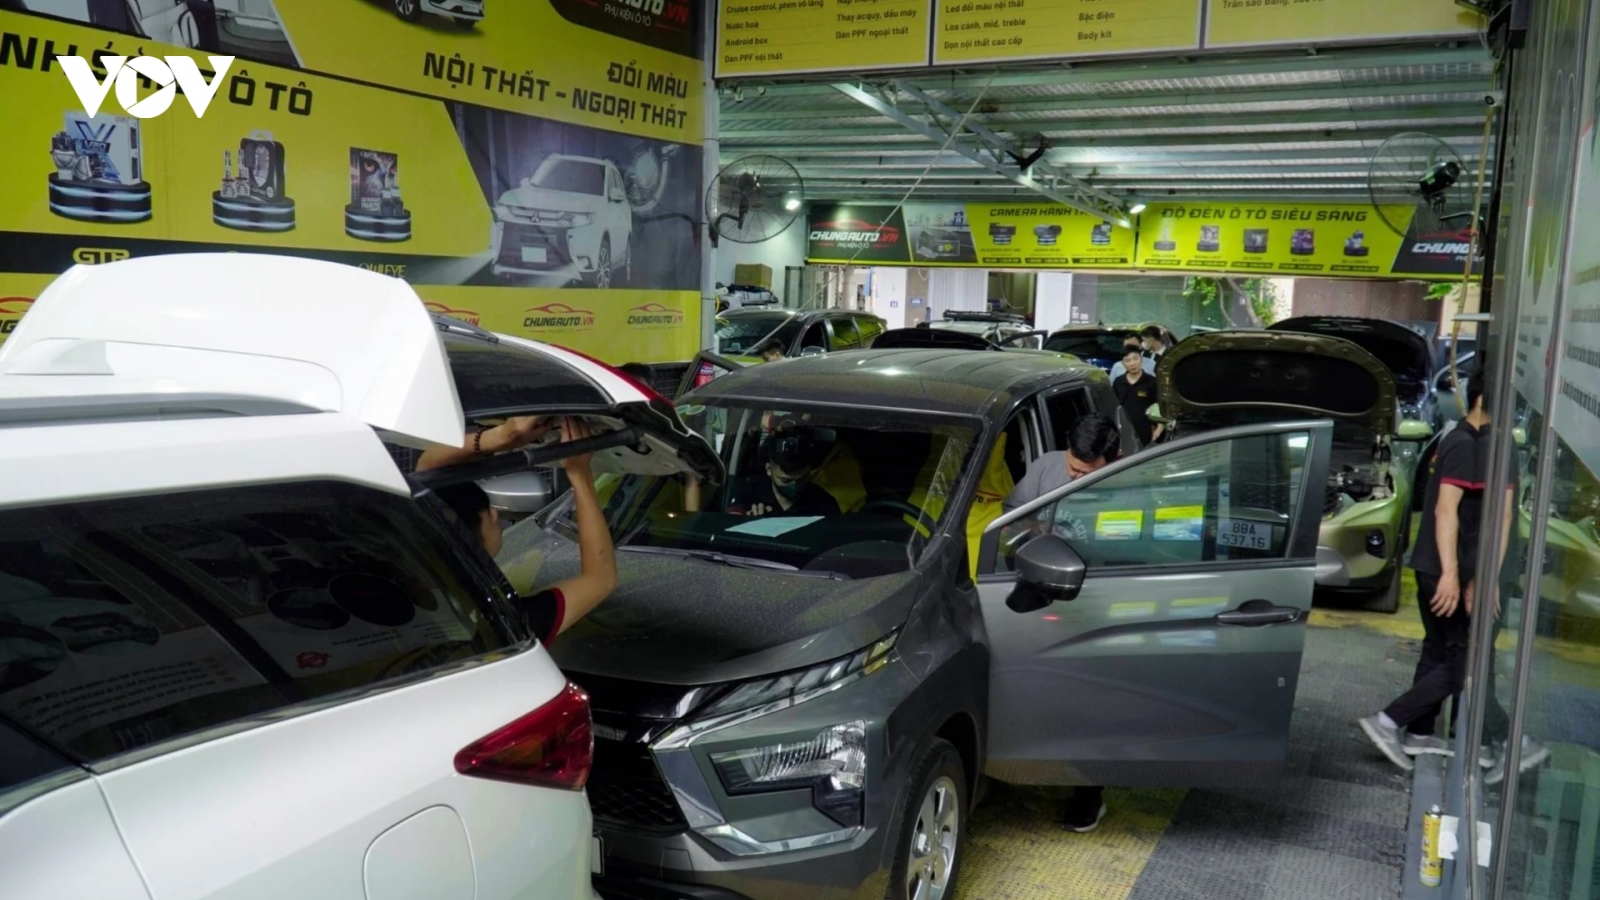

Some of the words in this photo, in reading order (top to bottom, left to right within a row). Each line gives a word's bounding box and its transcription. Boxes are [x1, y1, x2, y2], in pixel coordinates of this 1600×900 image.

[727, 6, 748, 14] Cruise
[750, 3, 777, 13] control,
[946, 5, 960, 13] Led
[994, 1, 1006, 11] nội
[837, 14, 854, 22] Thay
[900, 8, 917, 18] máy
[1096, 11, 1115, 22] điện
[1002, 18, 1026, 26] treble
[852, 29, 867, 37] PPF
[869, 27, 890, 38] ngoại
[892, 26, 909, 34] thất
[1078, 31, 1098, 41] Body
[1101, 30, 1112, 38] kit
[726, 37, 753, 46] Android
[755, 37, 768, 45] box
[944, 41, 958, 51] Dọn
[961, 39, 972, 50] nội
[974, 38, 990, 47] thất
[992, 38, 1006, 46] cao
[1008, 36, 1023, 47] cấp
[740, 53, 754, 62] PPF
[607, 60, 642, 89] ĐỔI
[647, 71, 688, 99] MÀU
[229, 69, 256, 107] Ô
[265, 81, 313, 117] TÔ
[423, 51, 475, 89] NỘI
[482, 65, 550, 102] THẤT
[572, 87, 636, 124] NGOẠI
[641, 102, 687, 129] THẤT
[990, 208, 1037, 217] CAMERA
[1161, 206, 1186, 220] ĐỘ
[1229, 206, 1242, 219] Ô
[1245, 207, 1267, 219] TÔ
[1271, 207, 1312, 220] SIÊU
[1315, 208, 1368, 221] SÁNG
[809, 231, 899, 242] CHUNGAUTO.VN
[523, 316, 595, 328] CHUNGAUTO.VN
[627, 315, 684, 324] CHUNGAUTO.VN
[1233, 523, 1256, 535] 88A
[1222, 533, 1265, 548] 537.16
